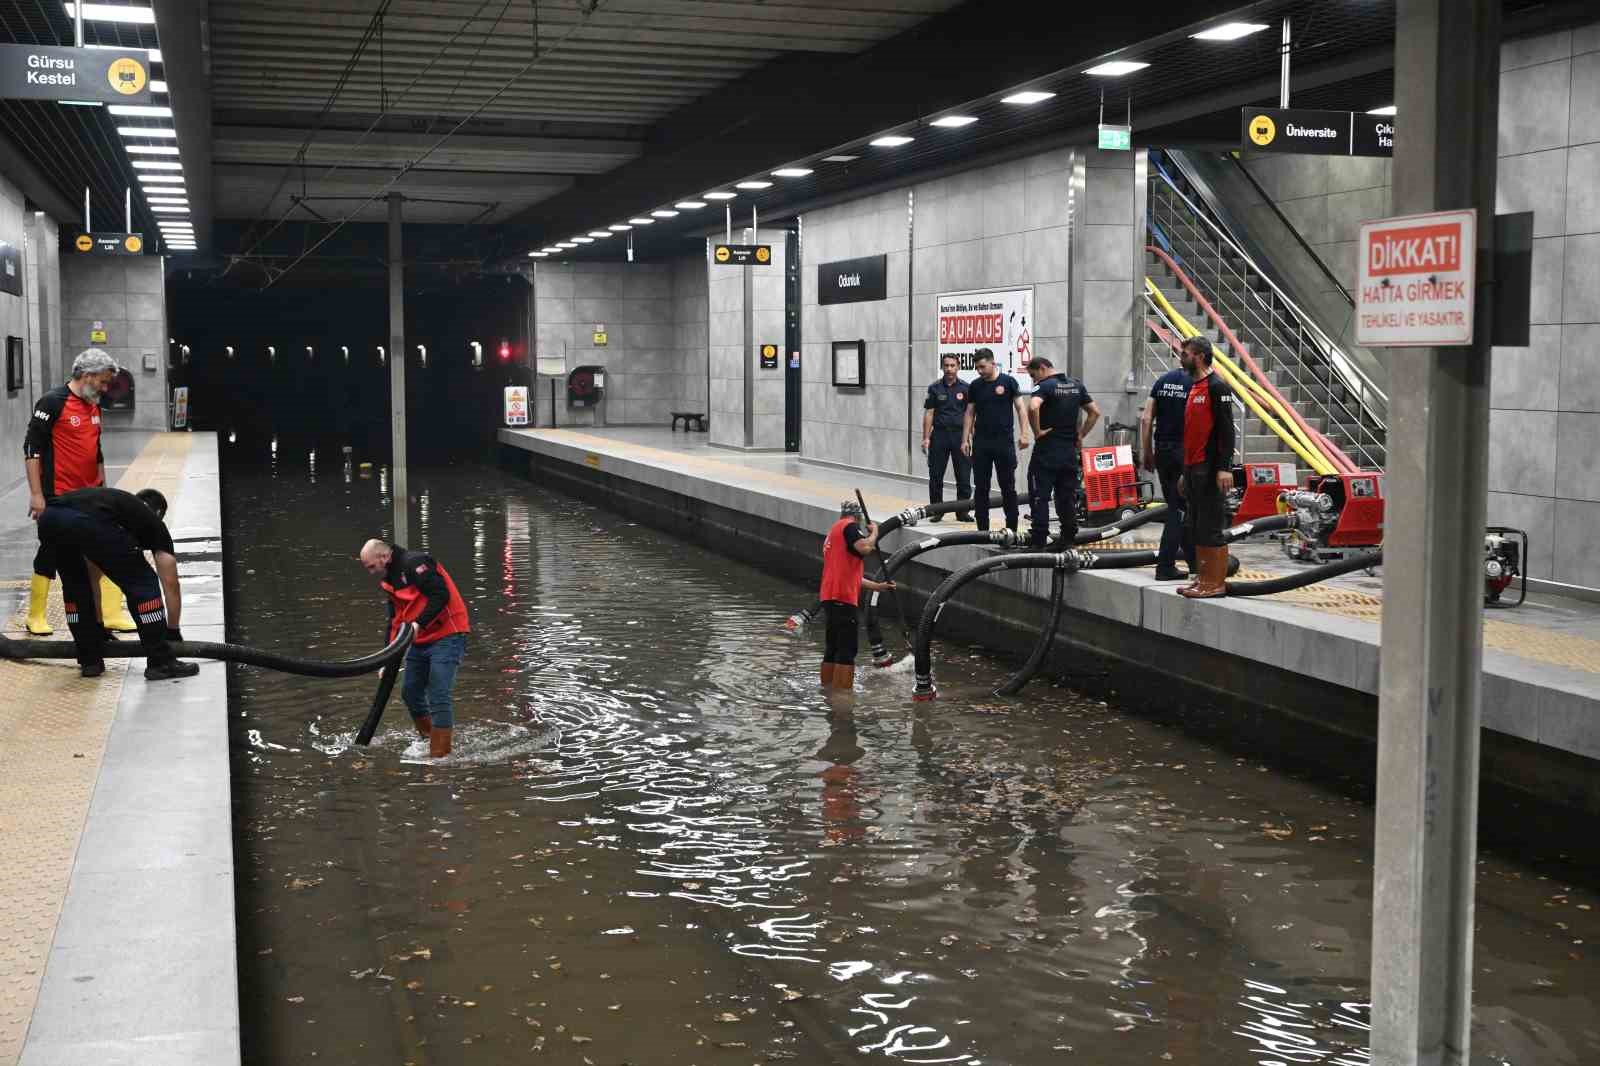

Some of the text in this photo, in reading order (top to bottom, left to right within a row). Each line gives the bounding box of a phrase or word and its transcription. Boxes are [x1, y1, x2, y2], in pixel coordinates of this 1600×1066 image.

[27, 54, 75, 69] Gürsu
[27, 71, 76, 86] Kestel
[1286, 123, 1337, 138] Üniversite
[1378, 136, 1393, 147] Ha
[1371, 235, 1457, 270] DİKKAT!
[1362, 279, 1465, 304] HATTA GİRMEK
[941, 317, 1002, 339] BAUHAUS
